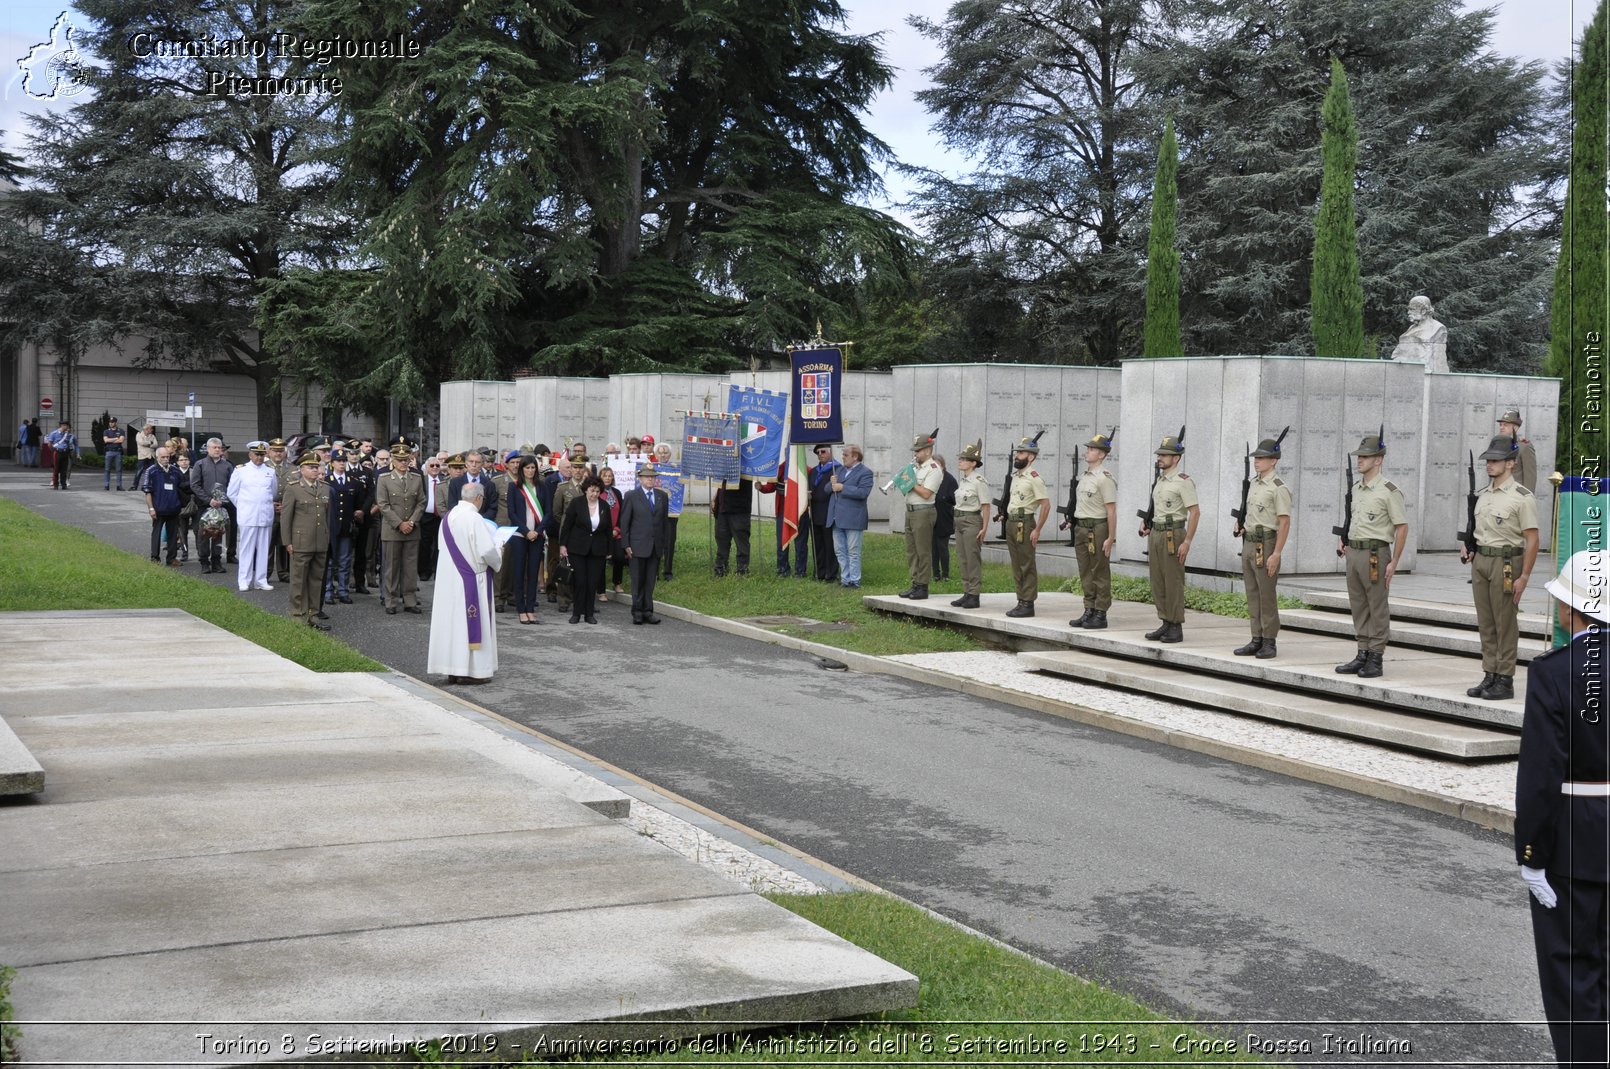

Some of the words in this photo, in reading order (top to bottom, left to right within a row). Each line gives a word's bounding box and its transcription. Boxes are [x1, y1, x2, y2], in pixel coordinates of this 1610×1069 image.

[798, 363, 834, 374] ASSOARMA
[803, 420, 828, 429] TORINO
[753, 459, 775, 473] TORINO
